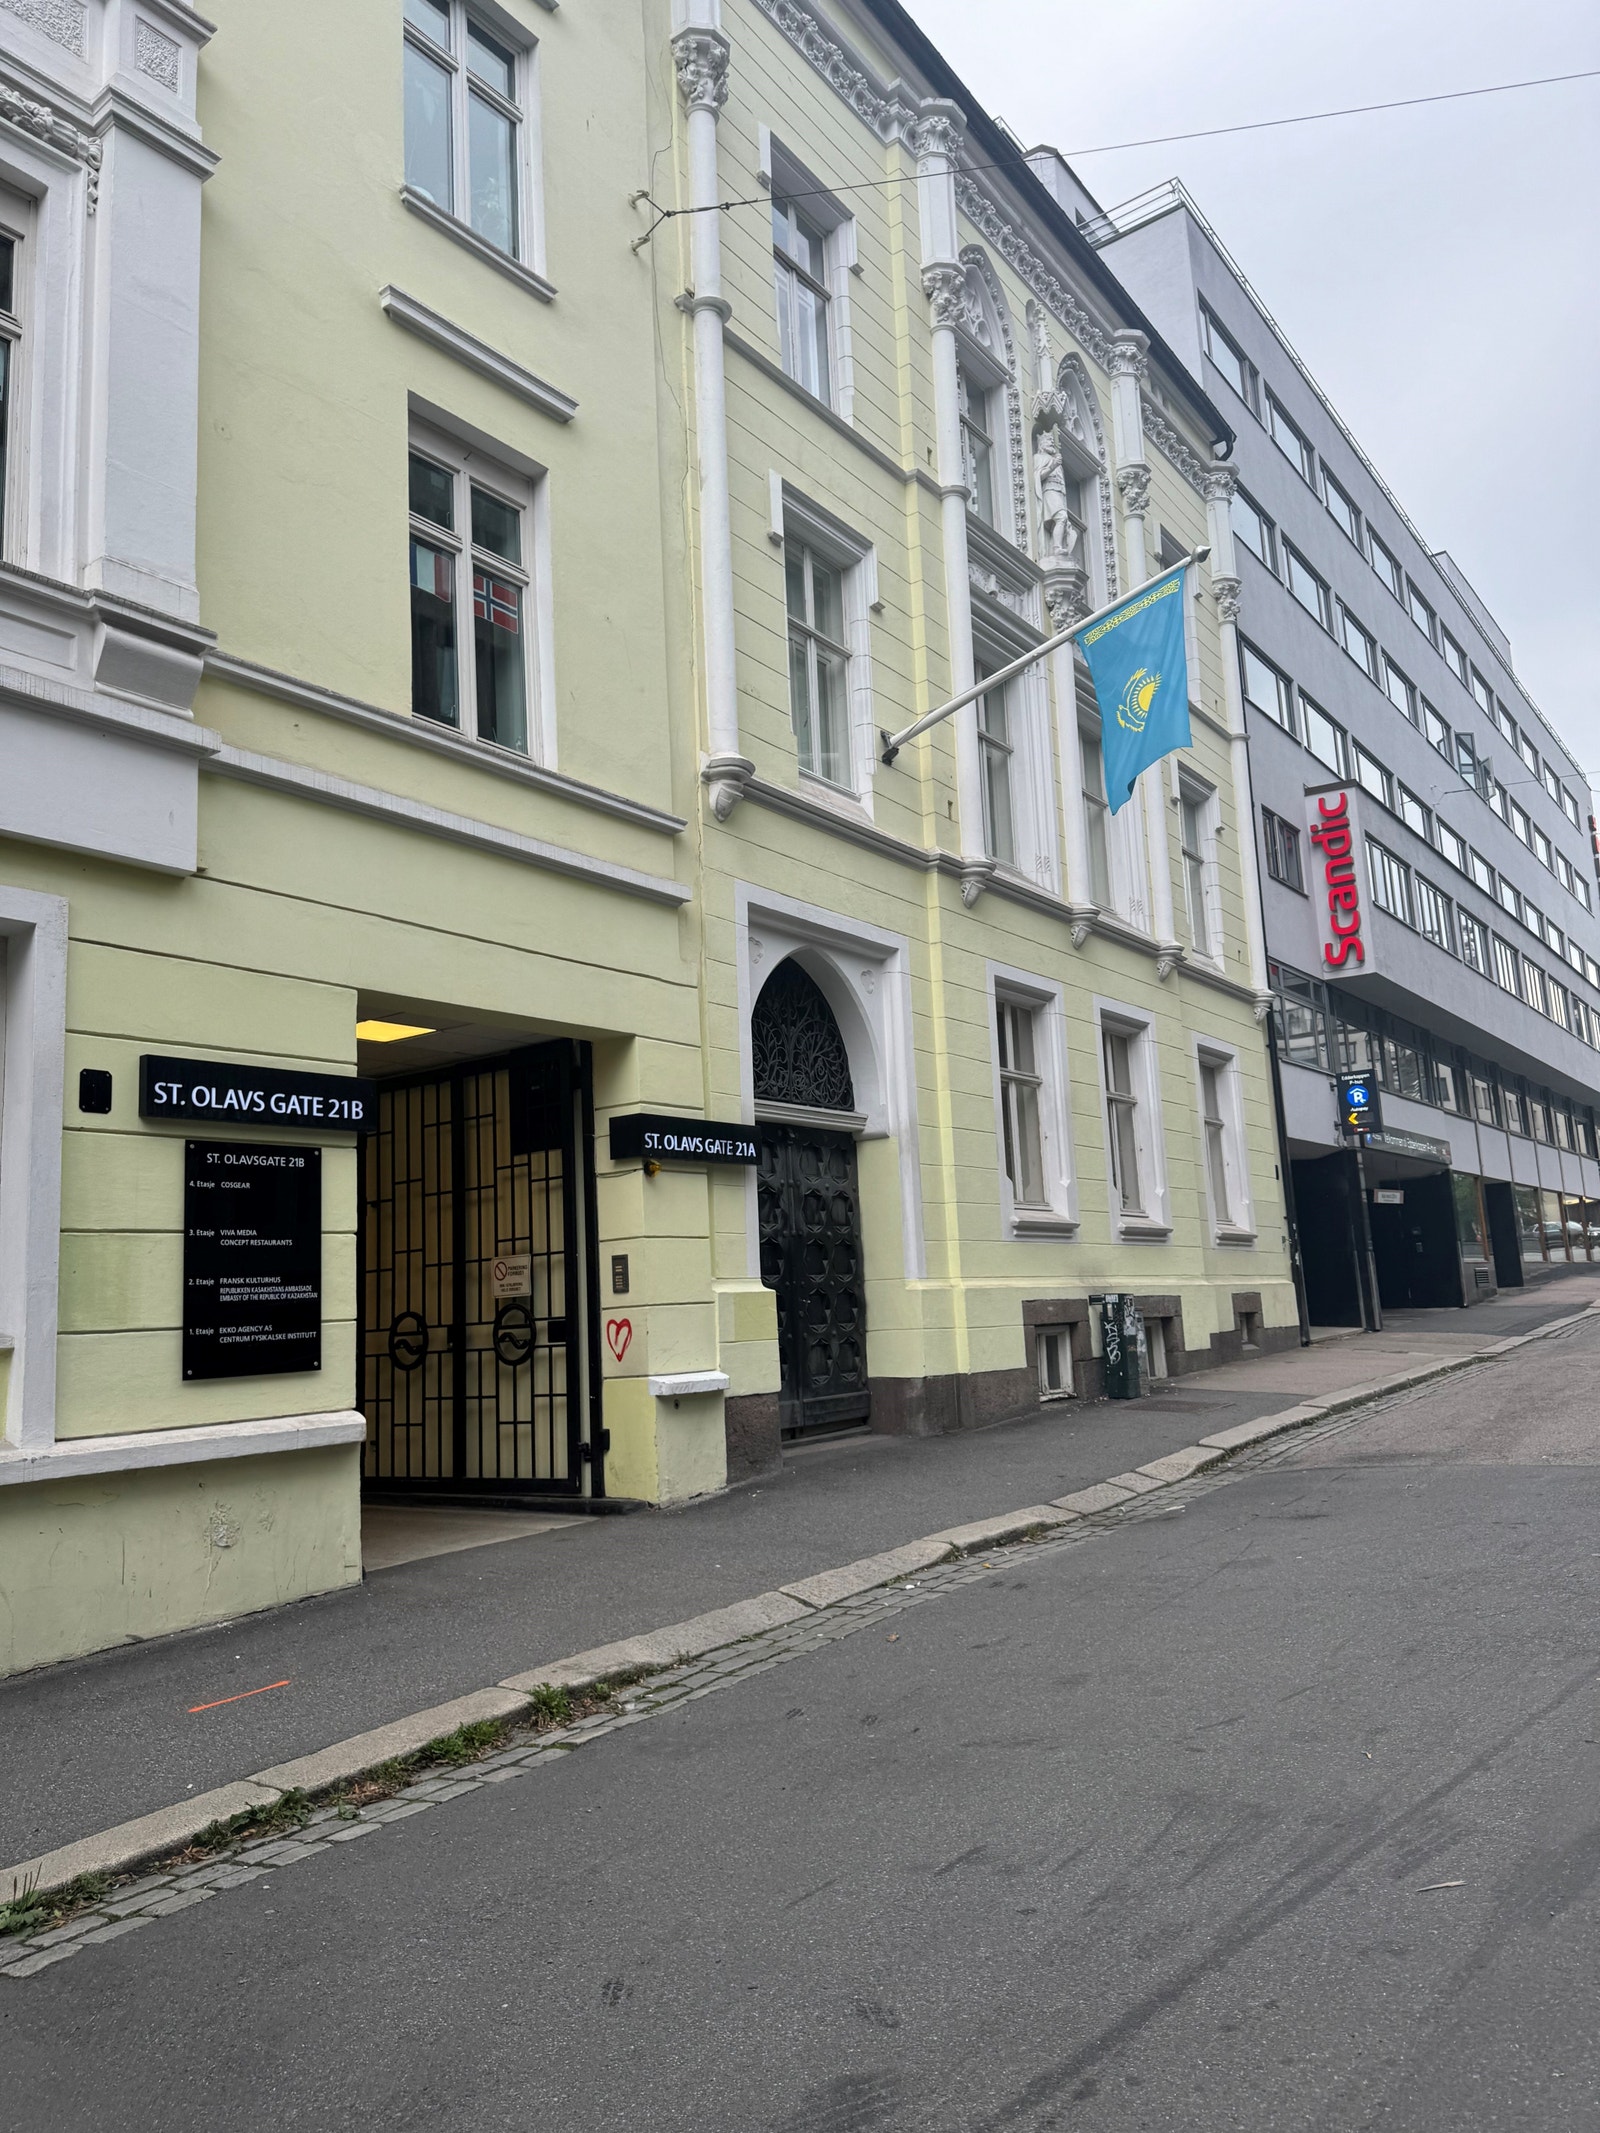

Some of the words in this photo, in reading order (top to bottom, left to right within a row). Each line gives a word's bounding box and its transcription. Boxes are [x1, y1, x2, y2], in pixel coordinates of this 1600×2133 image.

[1310, 792, 1364, 966] Scandic
[153, 1081, 186, 1106] ST.
[191, 1085, 266, 1113] OLAVS
[270, 1093, 324, 1117] GATE
[328, 1098, 364, 1120] 21B
[644, 1132, 662, 1150] ST.
[664, 1134, 703, 1153] OLAVS
[705, 1138, 734, 1156] GATE
[735, 1141, 757, 1157] 21A
[206, 1152, 221, 1164] ST.
[224, 1153, 286, 1166] OLAVSGATE
[288, 1157, 305, 1167] 21B
[189, 1180, 195, 1188] 4.
[197, 1180, 215, 1189] Etasje
[221, 1181, 251, 1189] COSGEAR
[196, 1228, 215, 1237] Etasje
[189, 1278, 195, 1286] 2.
[196, 1278, 214, 1287] Etasje
[246, 1276, 281, 1284] KULTURHUS
[220, 1294, 242, 1302] EMBASSY
[195, 1327, 214, 1336] Etasje
[219, 1326, 237, 1334] EKKO
[237, 1325, 263, 1333] AGENCY
[264, 1324, 273, 1332] AS
[219, 1335, 250, 1343] CENTRUM
[251, 1332, 286, 1342] FYSIKALSKE
[287, 1331, 317, 1340] INSTITUTT
